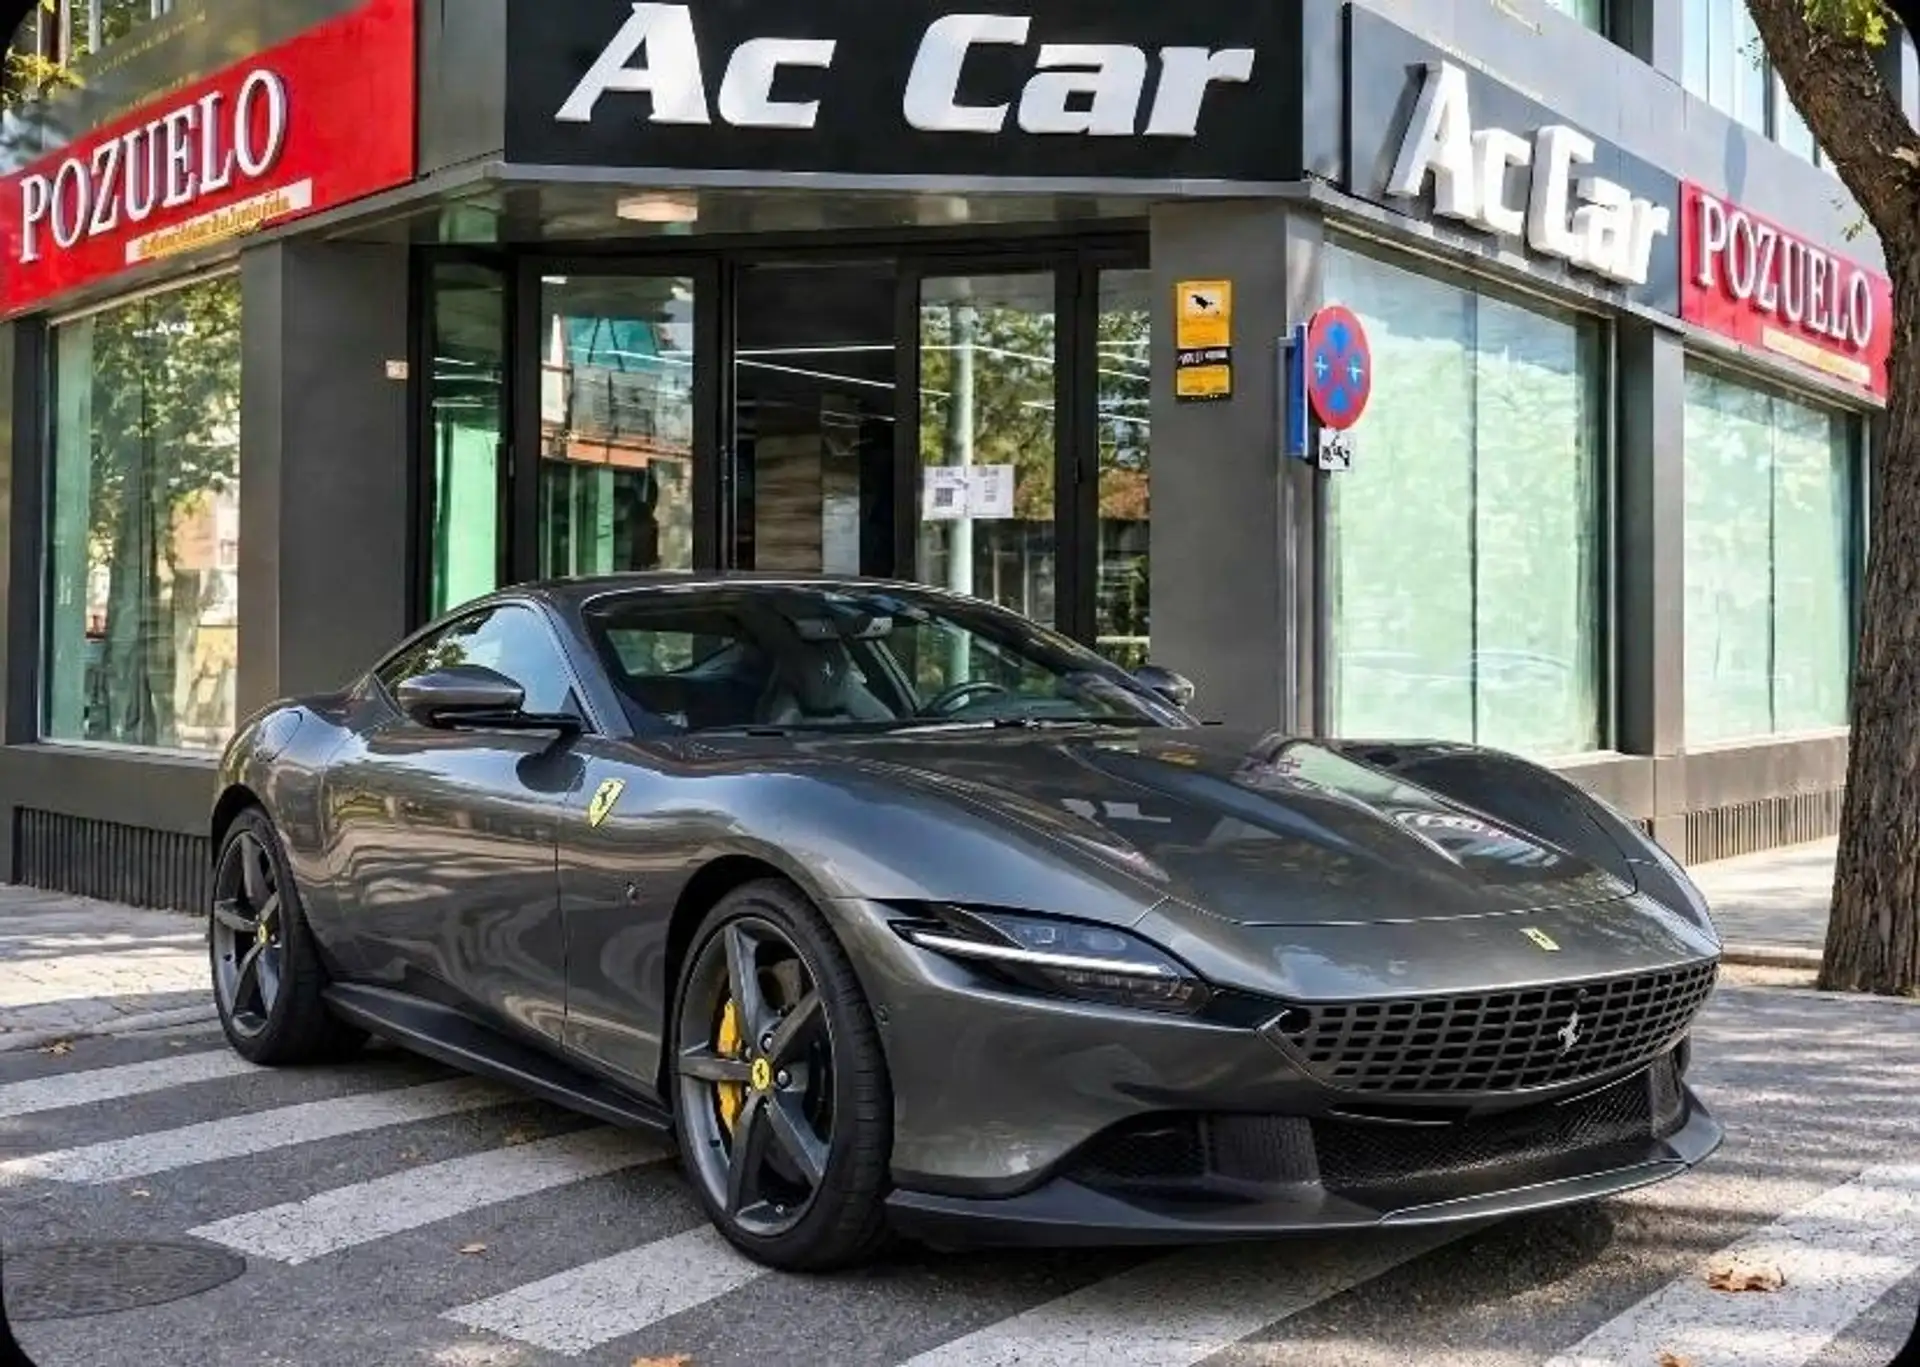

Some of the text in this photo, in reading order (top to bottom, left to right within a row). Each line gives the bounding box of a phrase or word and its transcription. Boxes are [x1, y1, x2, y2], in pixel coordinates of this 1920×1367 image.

[554, 1, 1255, 137] Ac Car
[18, 69, 289, 265] POZUELO
[1698, 194, 1873, 349] POZUELO
